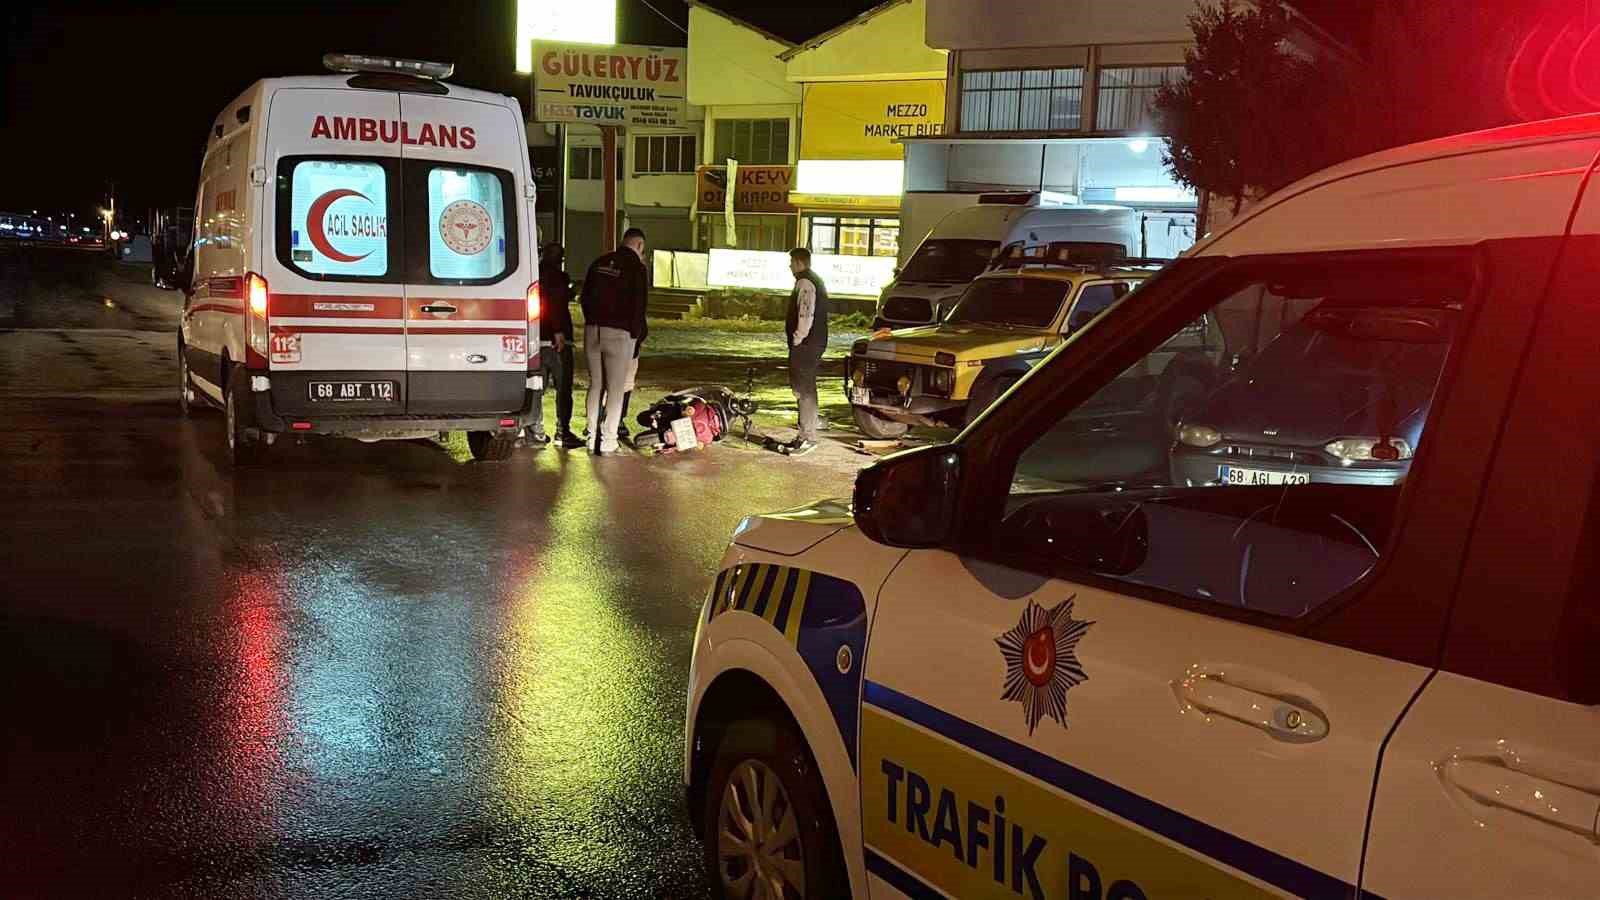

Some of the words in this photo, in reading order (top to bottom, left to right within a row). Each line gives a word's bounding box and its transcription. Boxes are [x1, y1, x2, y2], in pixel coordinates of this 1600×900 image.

[542, 50, 680, 82] GÜLERYÜZ
[567, 84, 655, 102] TAVUKÇULUK
[887, 104, 927, 117] MEZZO
[311, 115, 477, 150] AMBULANS
[864, 124, 913, 137] MARKET
[327, 214, 349, 236] ACİL
[273, 335, 298, 352] 112
[505, 338, 524, 352] 112
[317, 383, 333, 398] 68
[340, 383, 362, 398] ABT
[370, 383, 391, 398] 112
[1229, 469, 1244, 484] 68
[880, 758, 1048, 900] TRAFİK
